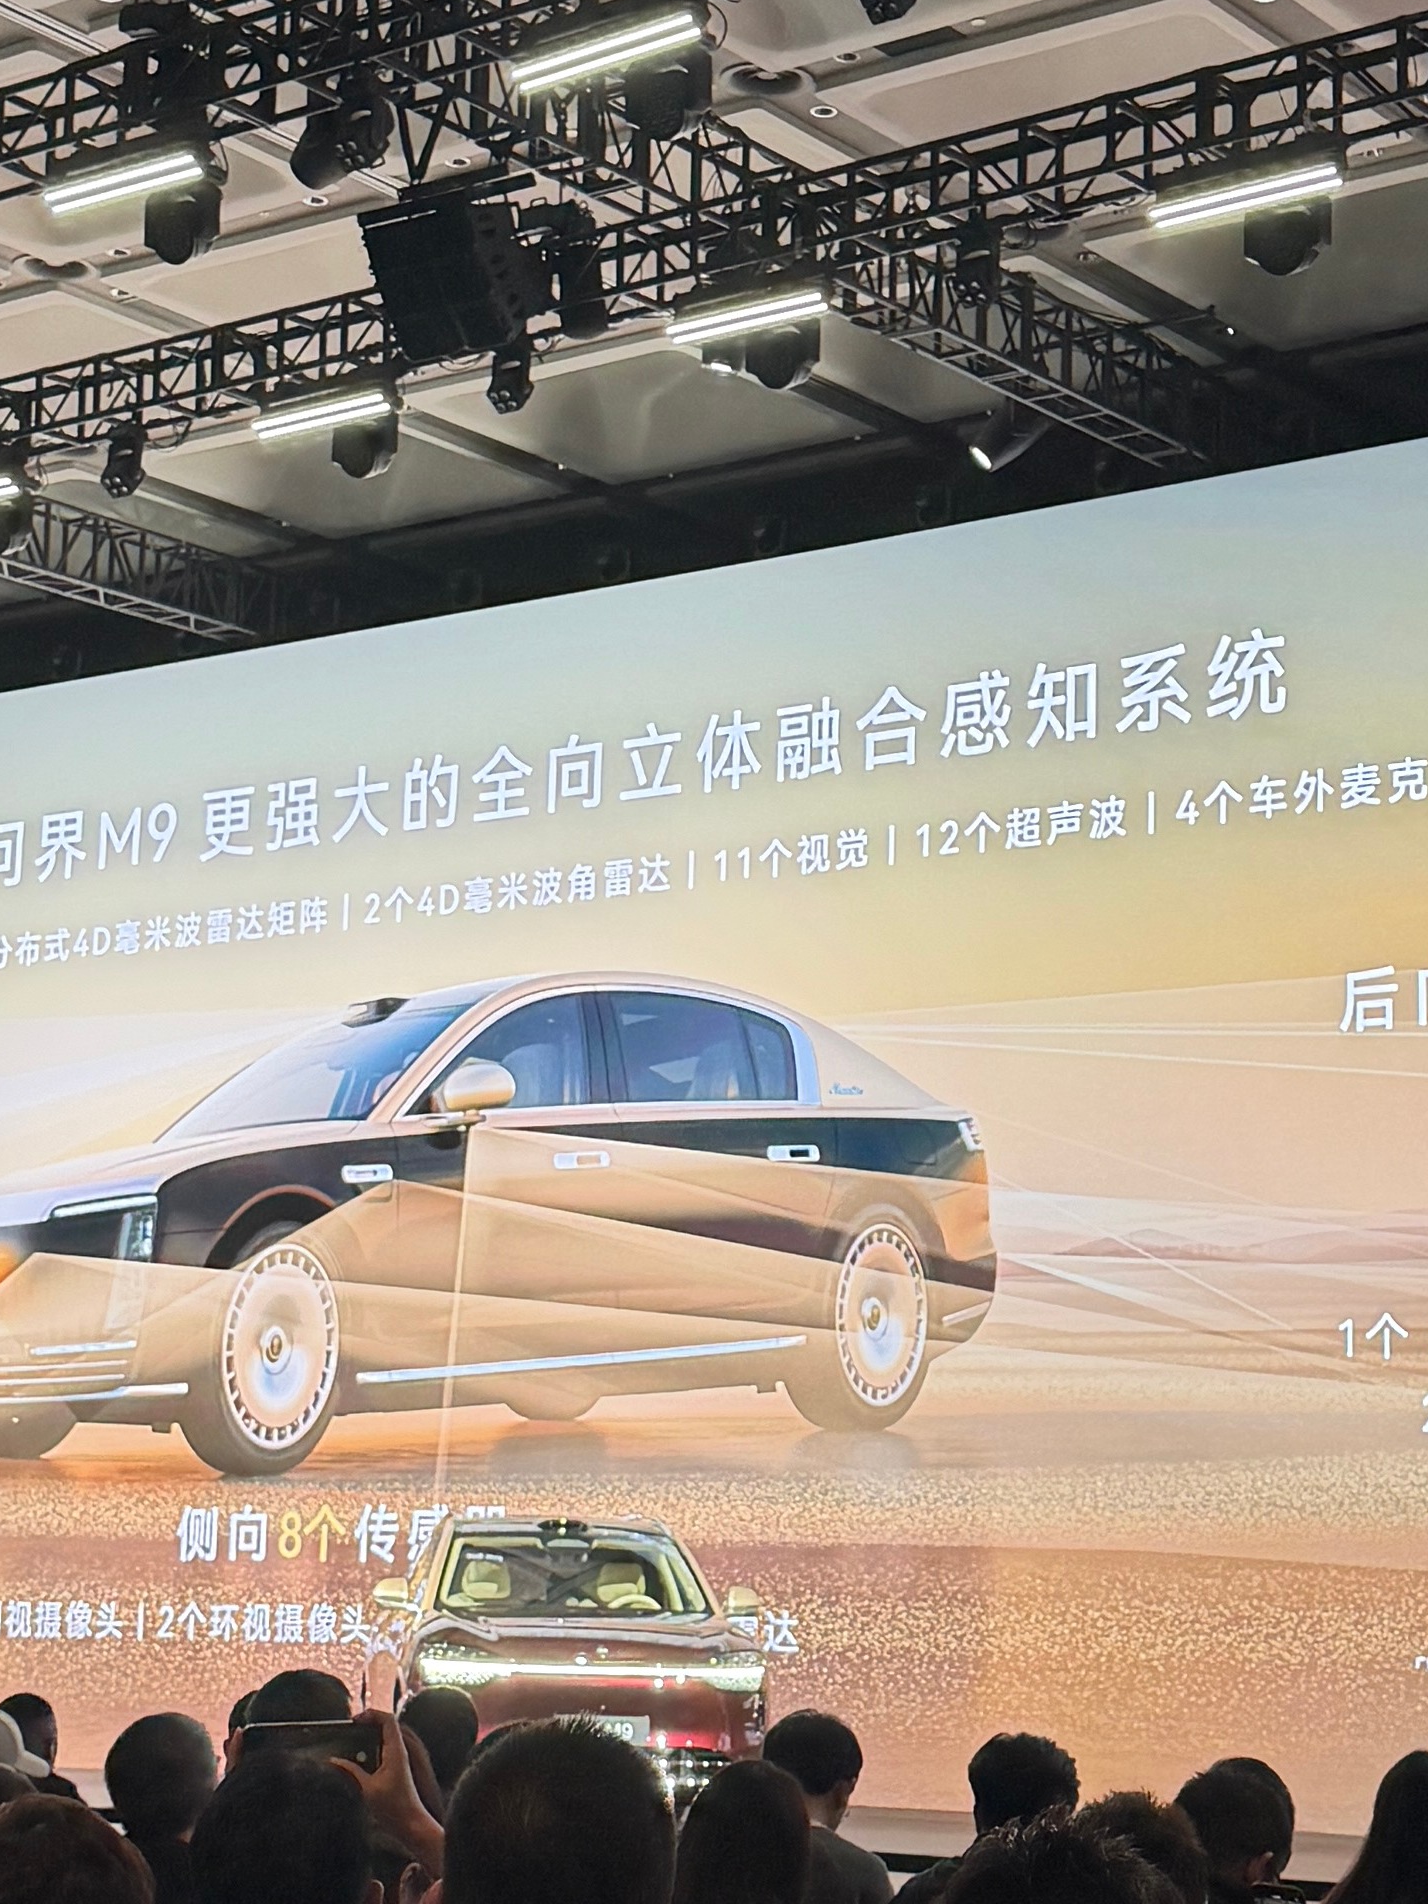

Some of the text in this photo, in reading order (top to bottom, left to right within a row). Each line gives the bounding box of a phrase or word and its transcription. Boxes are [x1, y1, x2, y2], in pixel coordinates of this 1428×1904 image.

[199, 628, 1290, 863] 更强大的全向立体融合感知系统
[363, 852, 671, 924] 2个4D毫米波角雷达
[714, 827, 869, 882] 11个视觉
[915, 794, 1127, 858] 12个超声波
[1338, 1312, 1409, 1360] 1个
[156, 1602, 372, 1645] 2个环视摄像头
